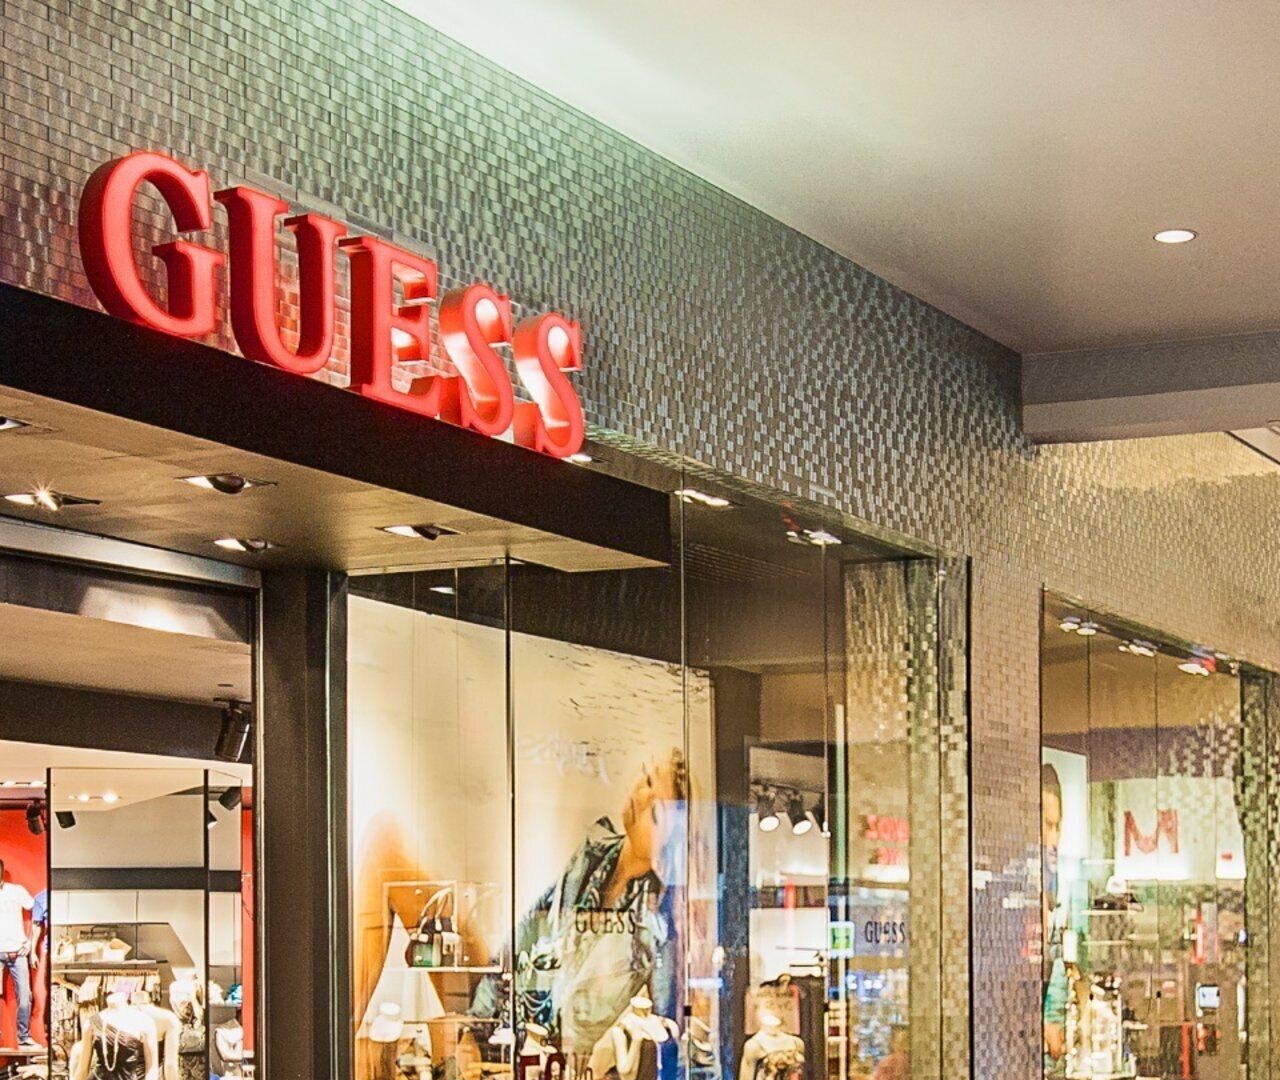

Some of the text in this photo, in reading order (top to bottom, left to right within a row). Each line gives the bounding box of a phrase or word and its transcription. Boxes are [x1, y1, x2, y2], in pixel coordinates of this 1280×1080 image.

[78, 150, 585, 460] GUESS
[575, 907, 637, 935] GUESS
[864, 920, 907, 944] GUESS
